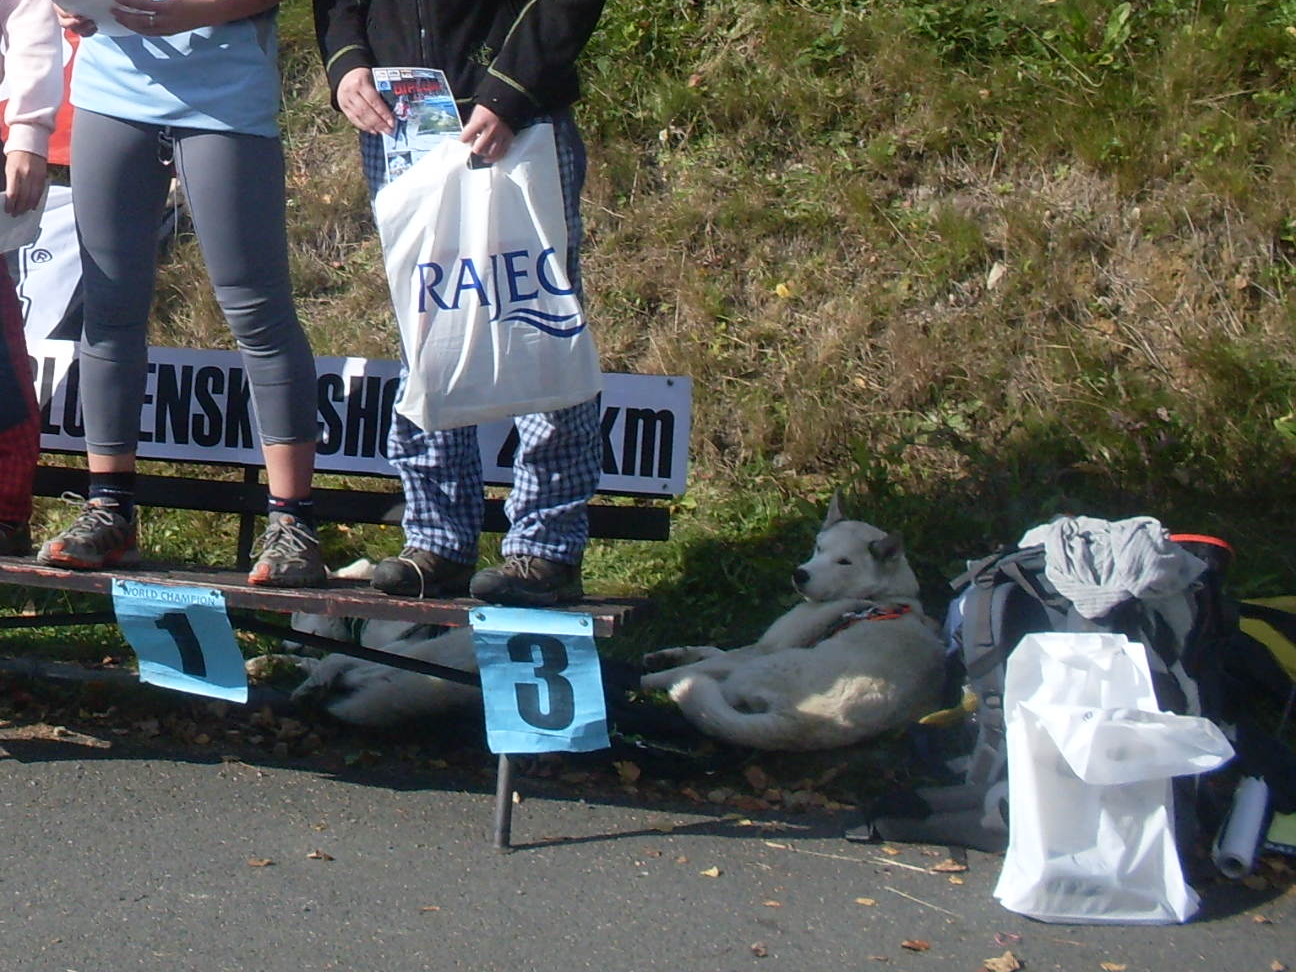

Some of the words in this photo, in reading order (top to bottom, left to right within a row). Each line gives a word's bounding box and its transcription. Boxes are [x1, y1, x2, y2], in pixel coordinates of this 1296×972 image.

[417, 246, 576, 322] RAJEC
[123, 586, 158, 600] WORLD
[161, 591, 216, 606] CHAMPION
[155, 613, 207, 677] 1
[507, 633, 575, 730] 3
